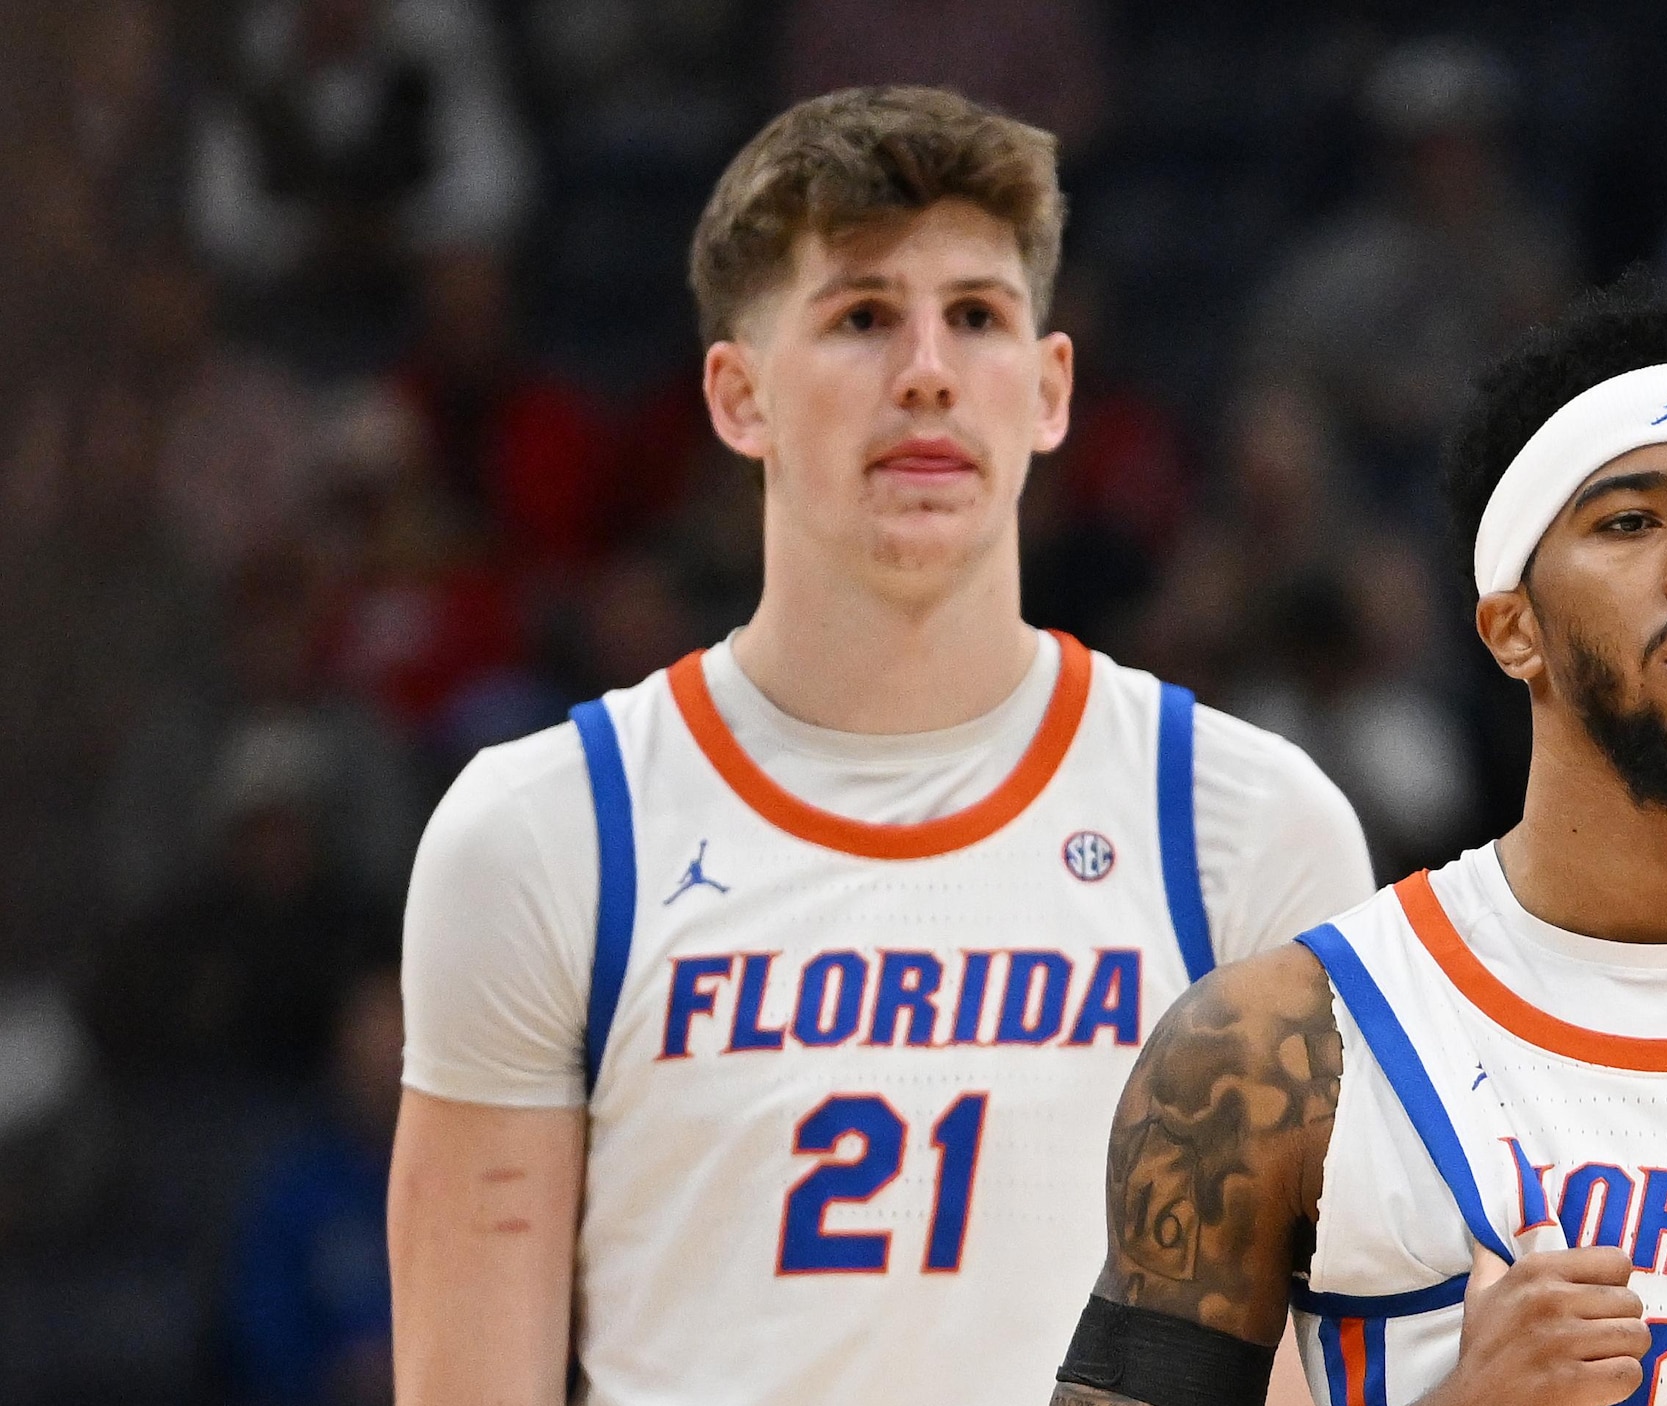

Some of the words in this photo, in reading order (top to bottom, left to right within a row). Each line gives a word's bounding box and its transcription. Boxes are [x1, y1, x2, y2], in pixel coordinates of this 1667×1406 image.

[1066, 834, 1113, 878] SEC
[655, 948, 1142, 1060] FLORIDA
[776, 1091, 989, 1277] 21
